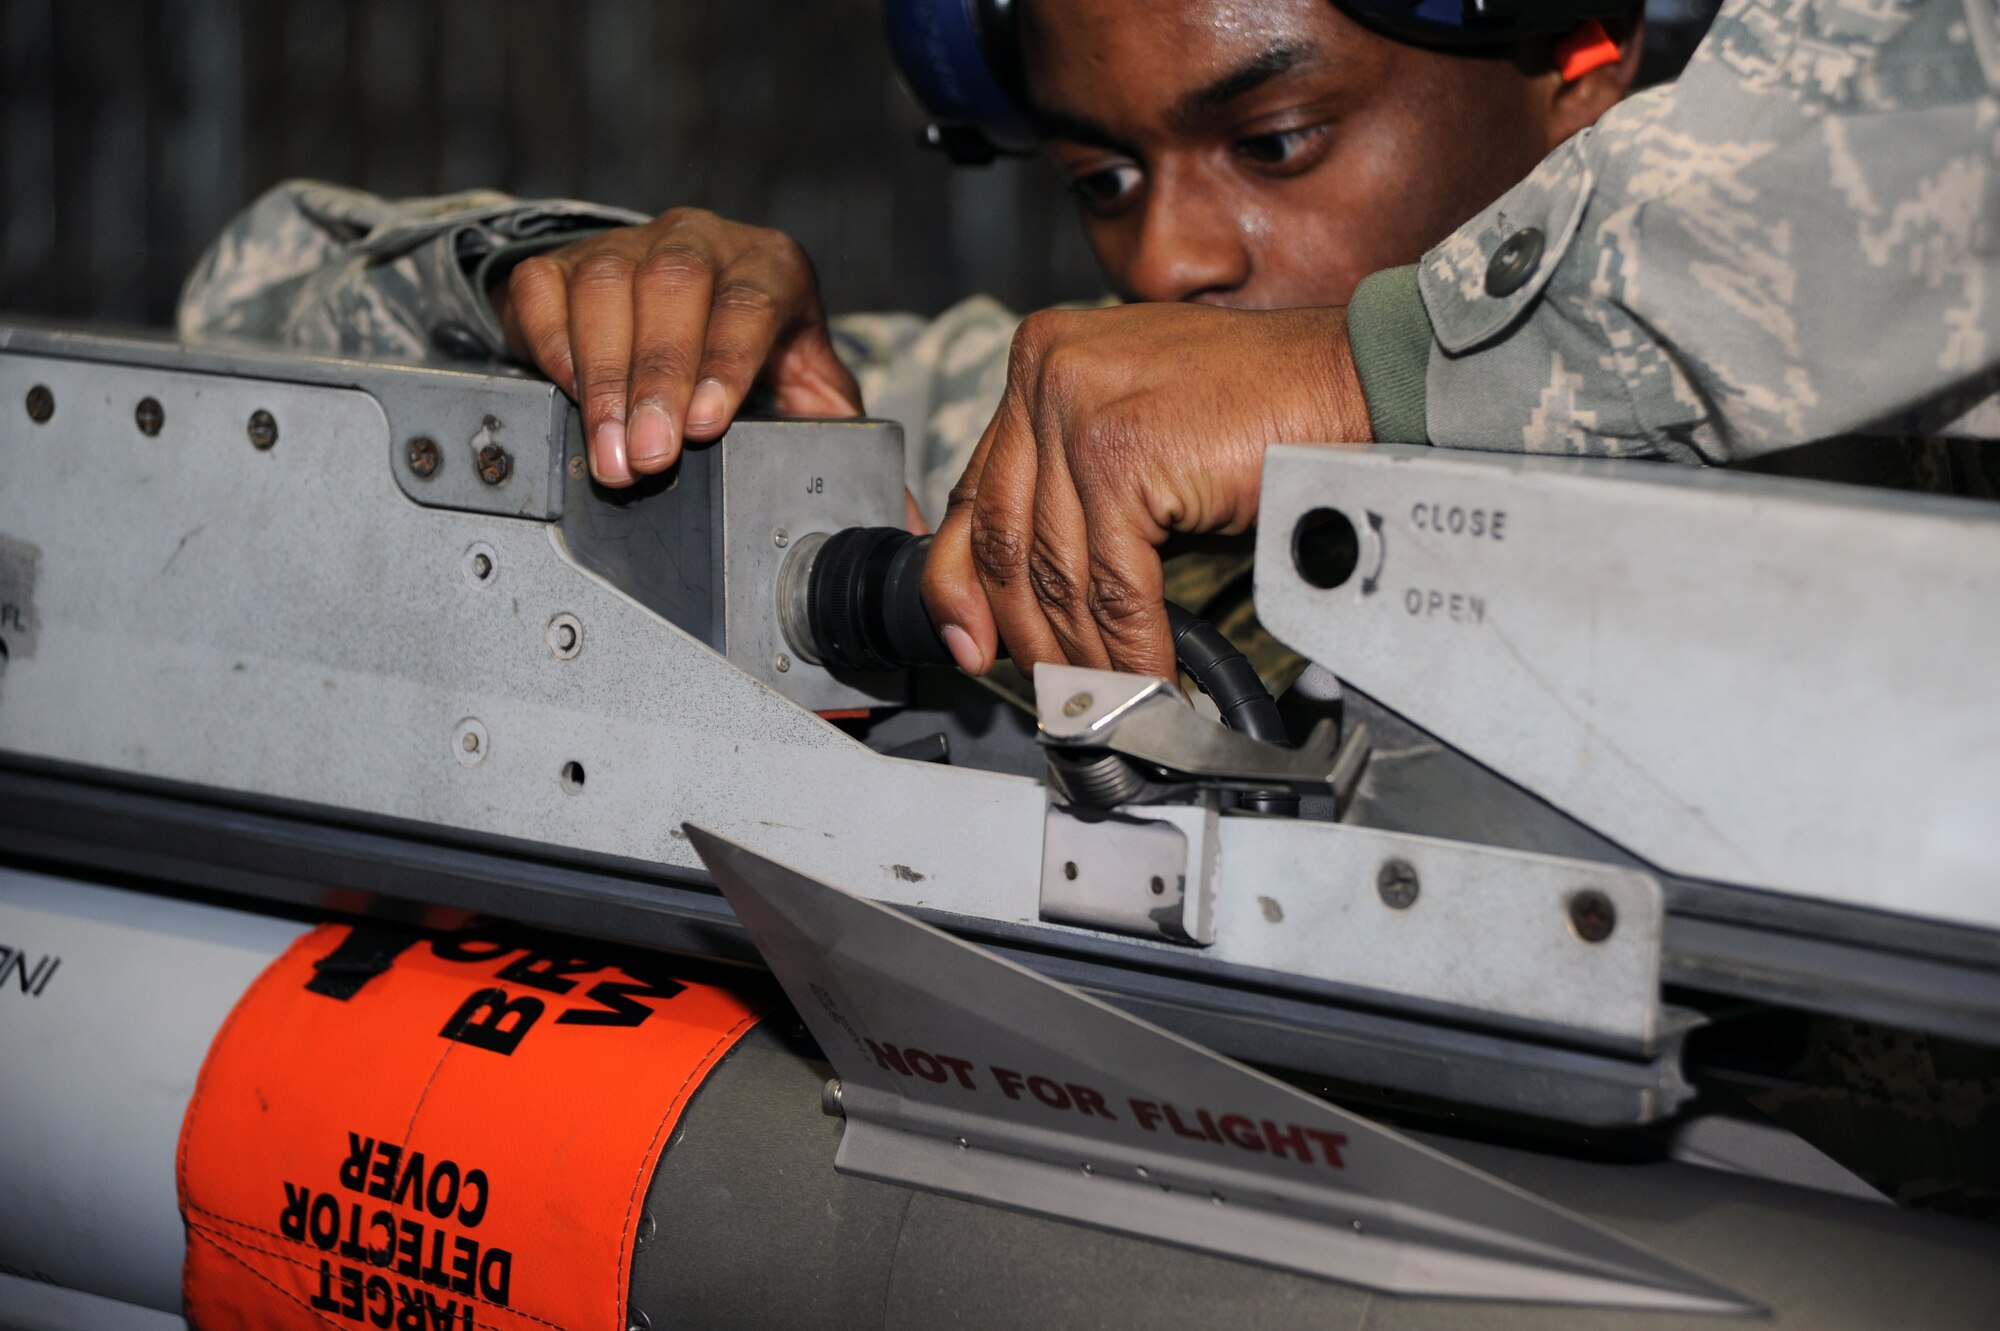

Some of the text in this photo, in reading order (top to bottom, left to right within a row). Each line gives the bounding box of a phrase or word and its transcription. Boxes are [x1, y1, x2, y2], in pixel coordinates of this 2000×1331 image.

[806, 476, 824, 494] J8
[1411, 502, 1507, 541] CLOSE
[1404, 587, 1486, 624] OPEN
[863, 1036, 1348, 1171] NOT FOR FLIGHT
[339, 1131, 490, 1229] COVER
[279, 1181, 513, 1306] DETECTOR
